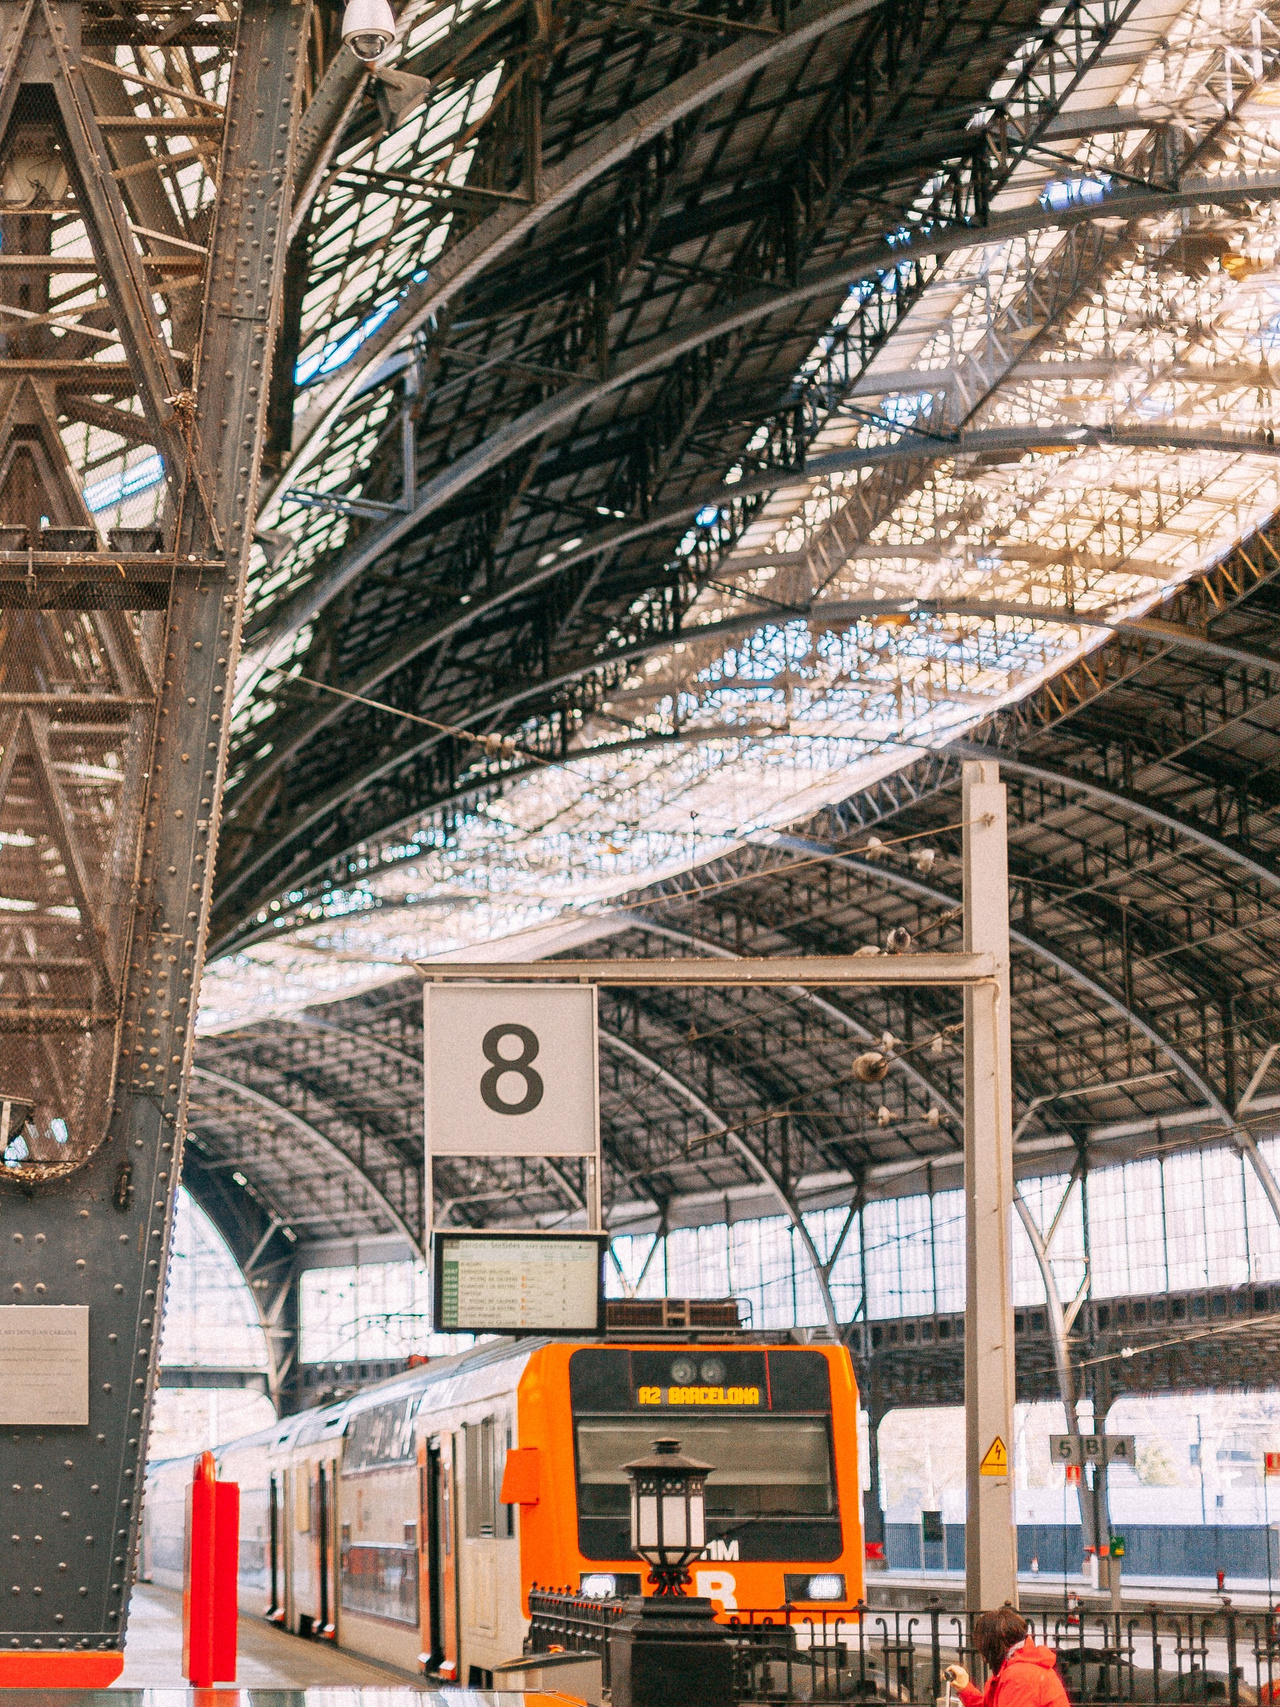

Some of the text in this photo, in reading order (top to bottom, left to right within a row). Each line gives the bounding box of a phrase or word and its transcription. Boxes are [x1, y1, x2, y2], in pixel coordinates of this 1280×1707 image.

[480, 1023, 544, 1116] 8
[668, 1386, 760, 1405] BARCELONA
[1059, 1439, 1072, 1458] 5
[1113, 1440, 1127, 1458] 4
